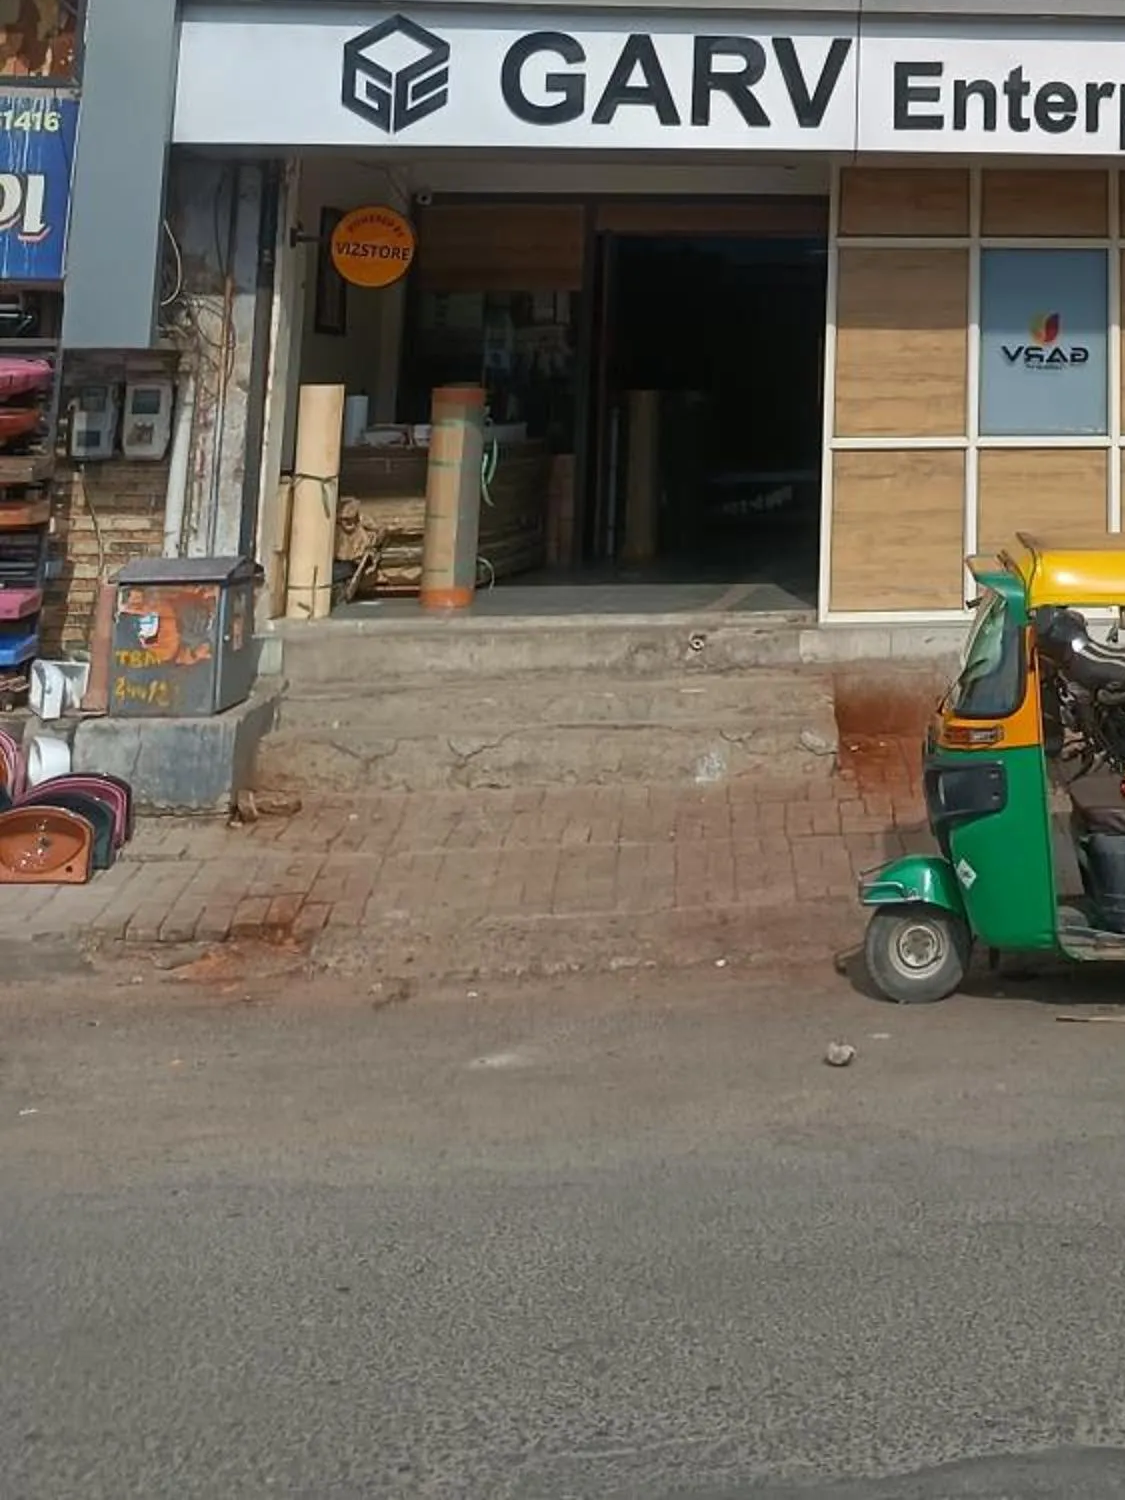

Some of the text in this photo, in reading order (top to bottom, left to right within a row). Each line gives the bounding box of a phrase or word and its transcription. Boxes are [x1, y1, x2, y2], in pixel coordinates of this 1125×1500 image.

[499, 30, 853, 128] GARV
[0, 110, 61, 132] 1416
[335, 242, 411, 261] VIZSTORE
